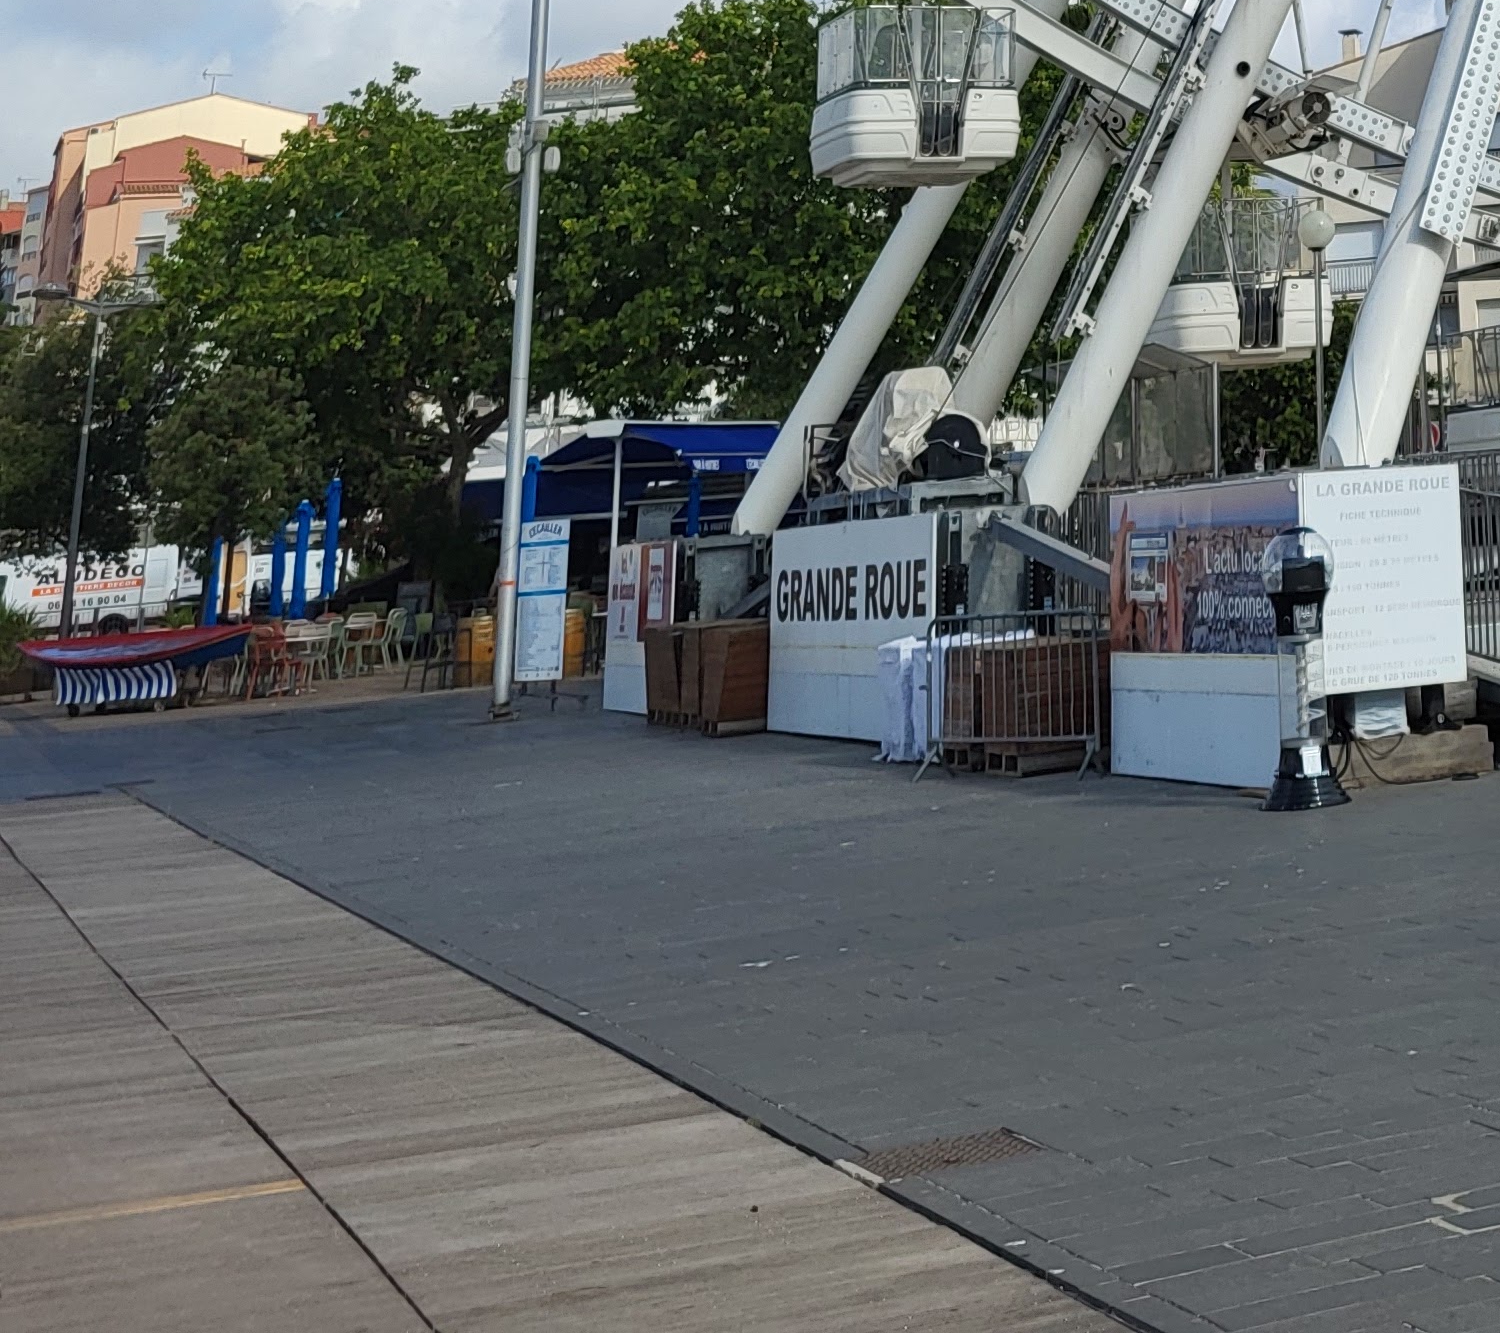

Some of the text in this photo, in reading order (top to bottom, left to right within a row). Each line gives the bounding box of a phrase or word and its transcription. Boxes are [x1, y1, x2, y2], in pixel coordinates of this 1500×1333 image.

[1316, 476, 1450, 497] LA GRANDE ROUE
[1339, 506, 1422, 521] FICHE TECHNIQUE
[776, 558, 927, 623] GRANDE ROUE
[48, 600, 61, 610] 06
[113, 594, 127, 603] 04
[1197, 590, 1225, 619] 100%
